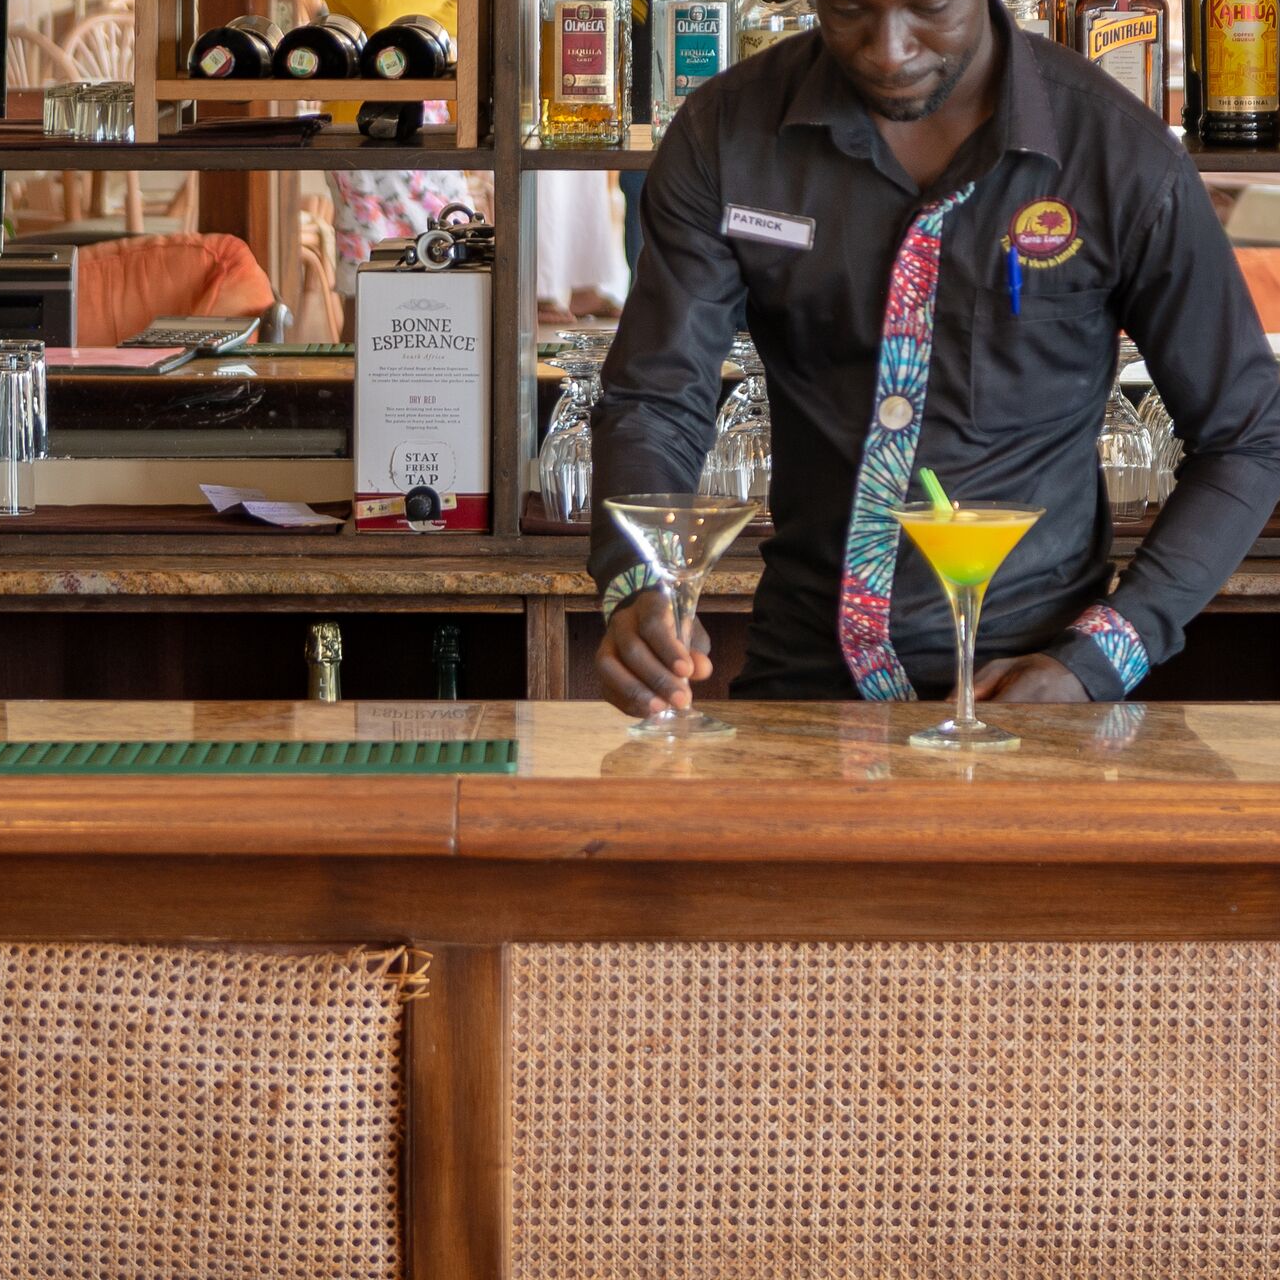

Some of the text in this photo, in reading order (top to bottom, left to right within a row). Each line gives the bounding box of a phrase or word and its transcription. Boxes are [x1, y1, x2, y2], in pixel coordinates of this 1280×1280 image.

[564, 19, 606, 33] OLMECA
[677, 20, 719, 33] OLMECA
[1094, 20, 1153, 53] COINTREAU
[567, 47, 603, 57] TEQUILA
[1234, 99, 1269, 107] ORIGINAL
[732, 211, 784, 232] PATRICK
[391, 317, 452, 333] BONNE
[371, 333, 477, 352] ESPERANCE
[405, 452, 439, 463] STAY
[405, 463, 439, 472] FRESH
[405, 473, 439, 486] TAP
